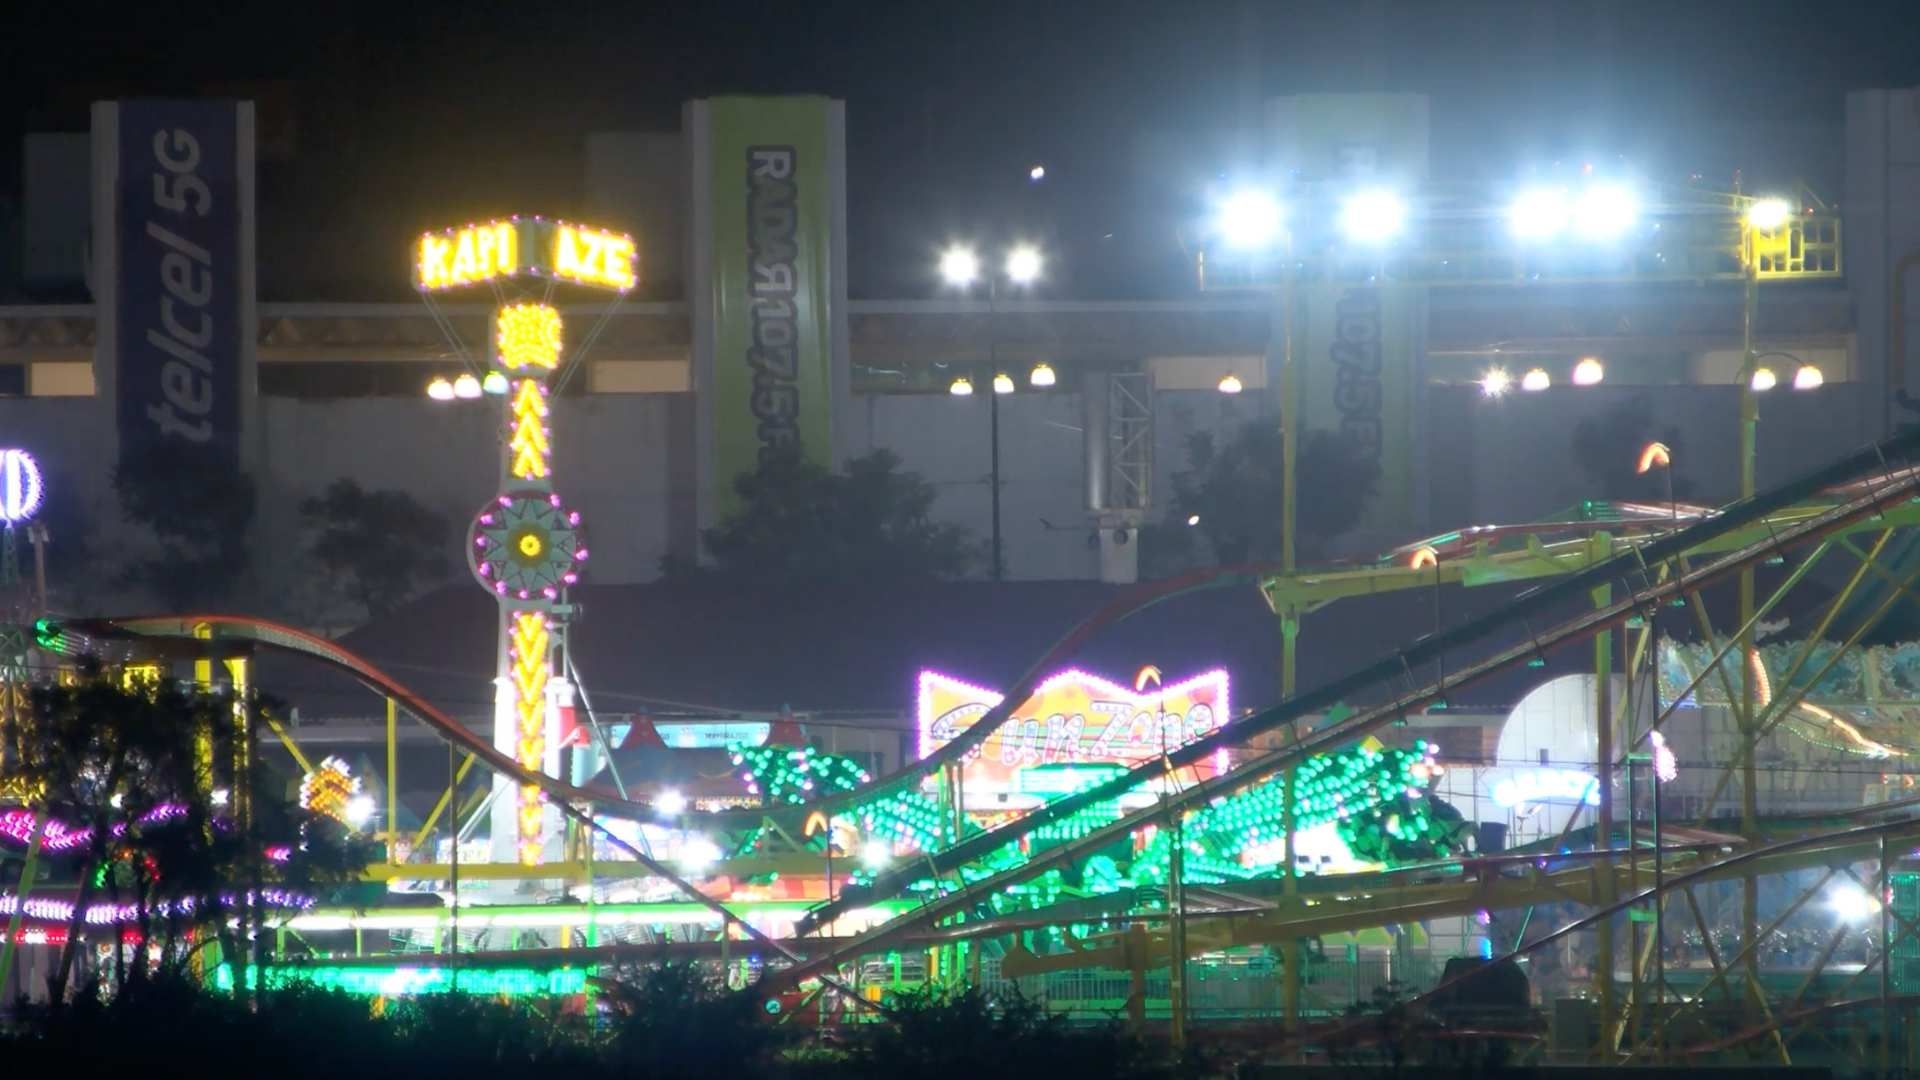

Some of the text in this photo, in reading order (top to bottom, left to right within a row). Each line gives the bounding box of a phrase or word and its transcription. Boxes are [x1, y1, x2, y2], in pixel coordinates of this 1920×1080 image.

[147, 129, 212, 442] telcel 5G
[1089, 699, 1215, 759] Zone
